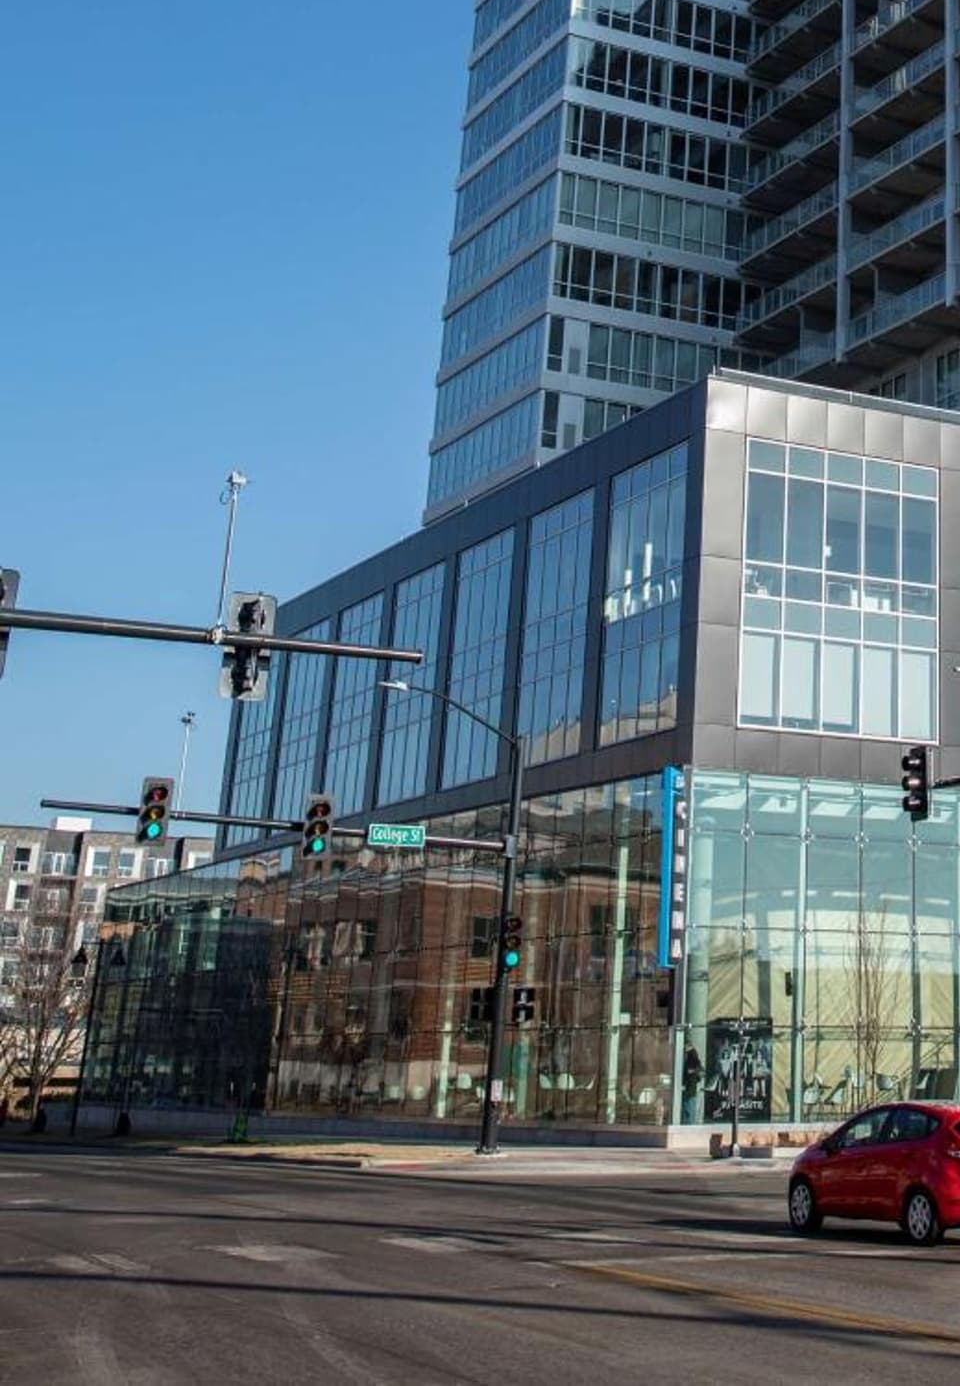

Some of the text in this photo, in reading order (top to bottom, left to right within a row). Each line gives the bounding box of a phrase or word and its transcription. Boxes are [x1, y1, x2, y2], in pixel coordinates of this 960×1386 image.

[373, 827, 420, 844] College St
[671, 801, 688, 959] CINEMA
[720, 1100, 764, 1110] PAASITE
